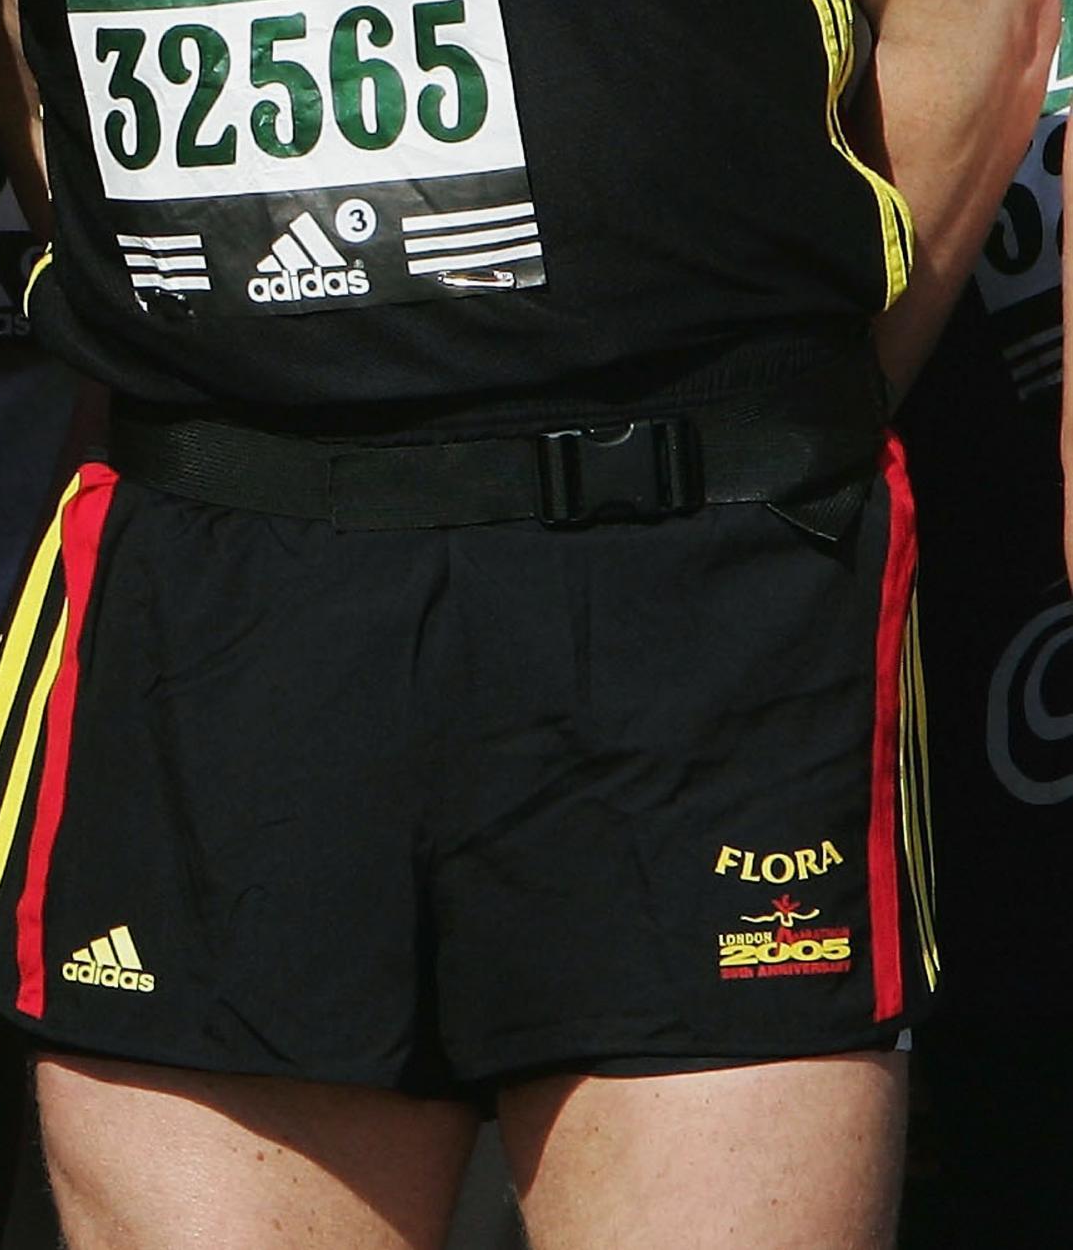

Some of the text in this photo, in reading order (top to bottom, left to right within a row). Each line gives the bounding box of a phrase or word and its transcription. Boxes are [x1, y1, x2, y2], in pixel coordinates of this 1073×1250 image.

[349, 208, 368, 232] 3
[247, 265, 371, 302] adidas
[714, 840, 844, 884] FLORA
[719, 931, 773, 946] LONDON
[719, 937, 851, 966] 2005
[62, 959, 155, 993] adidas
